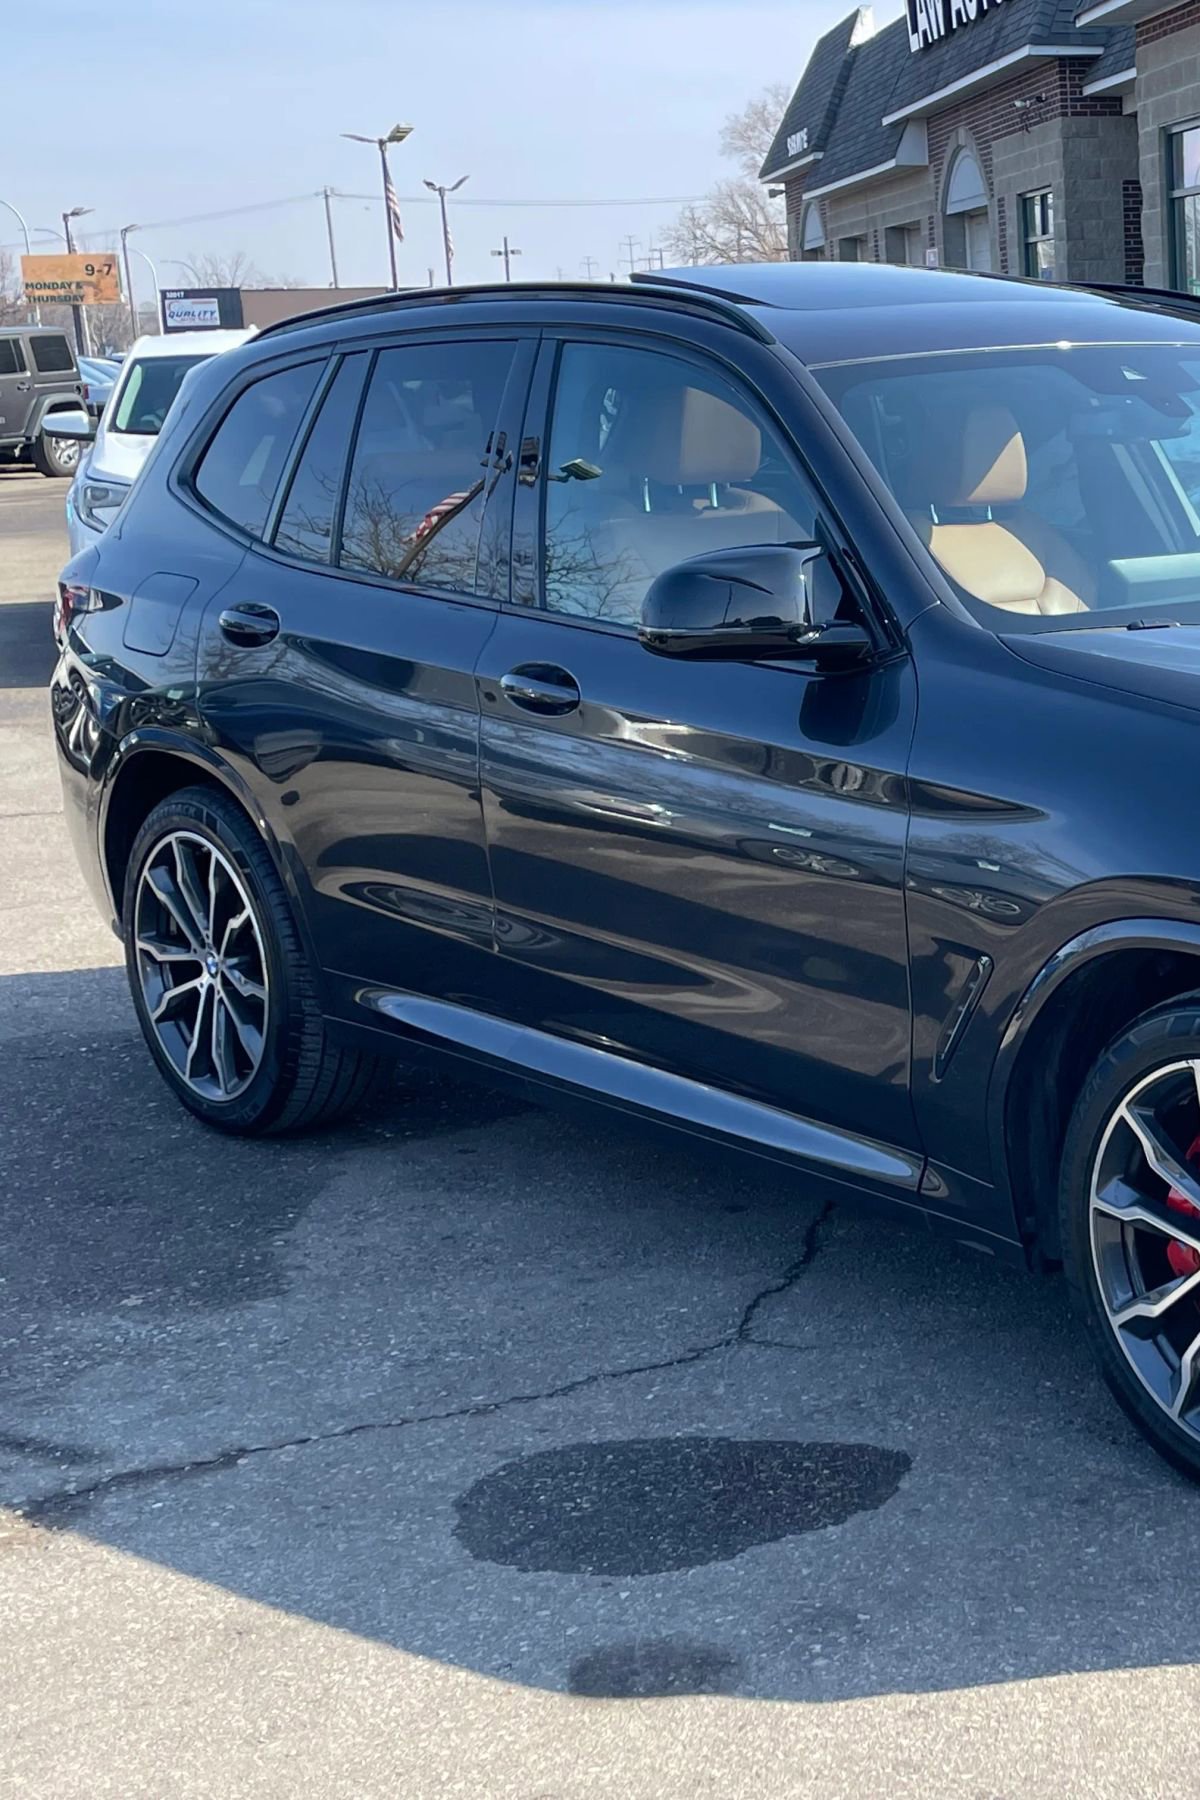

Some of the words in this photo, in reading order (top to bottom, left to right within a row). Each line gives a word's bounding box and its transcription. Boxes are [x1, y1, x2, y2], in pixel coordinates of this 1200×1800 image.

[84, 263, 112, 276] 9-7
[25, 281, 72, 290] MONDAY
[26, 295, 84, 303] THURSDAY
[168, 310, 217, 319] QUALITY
